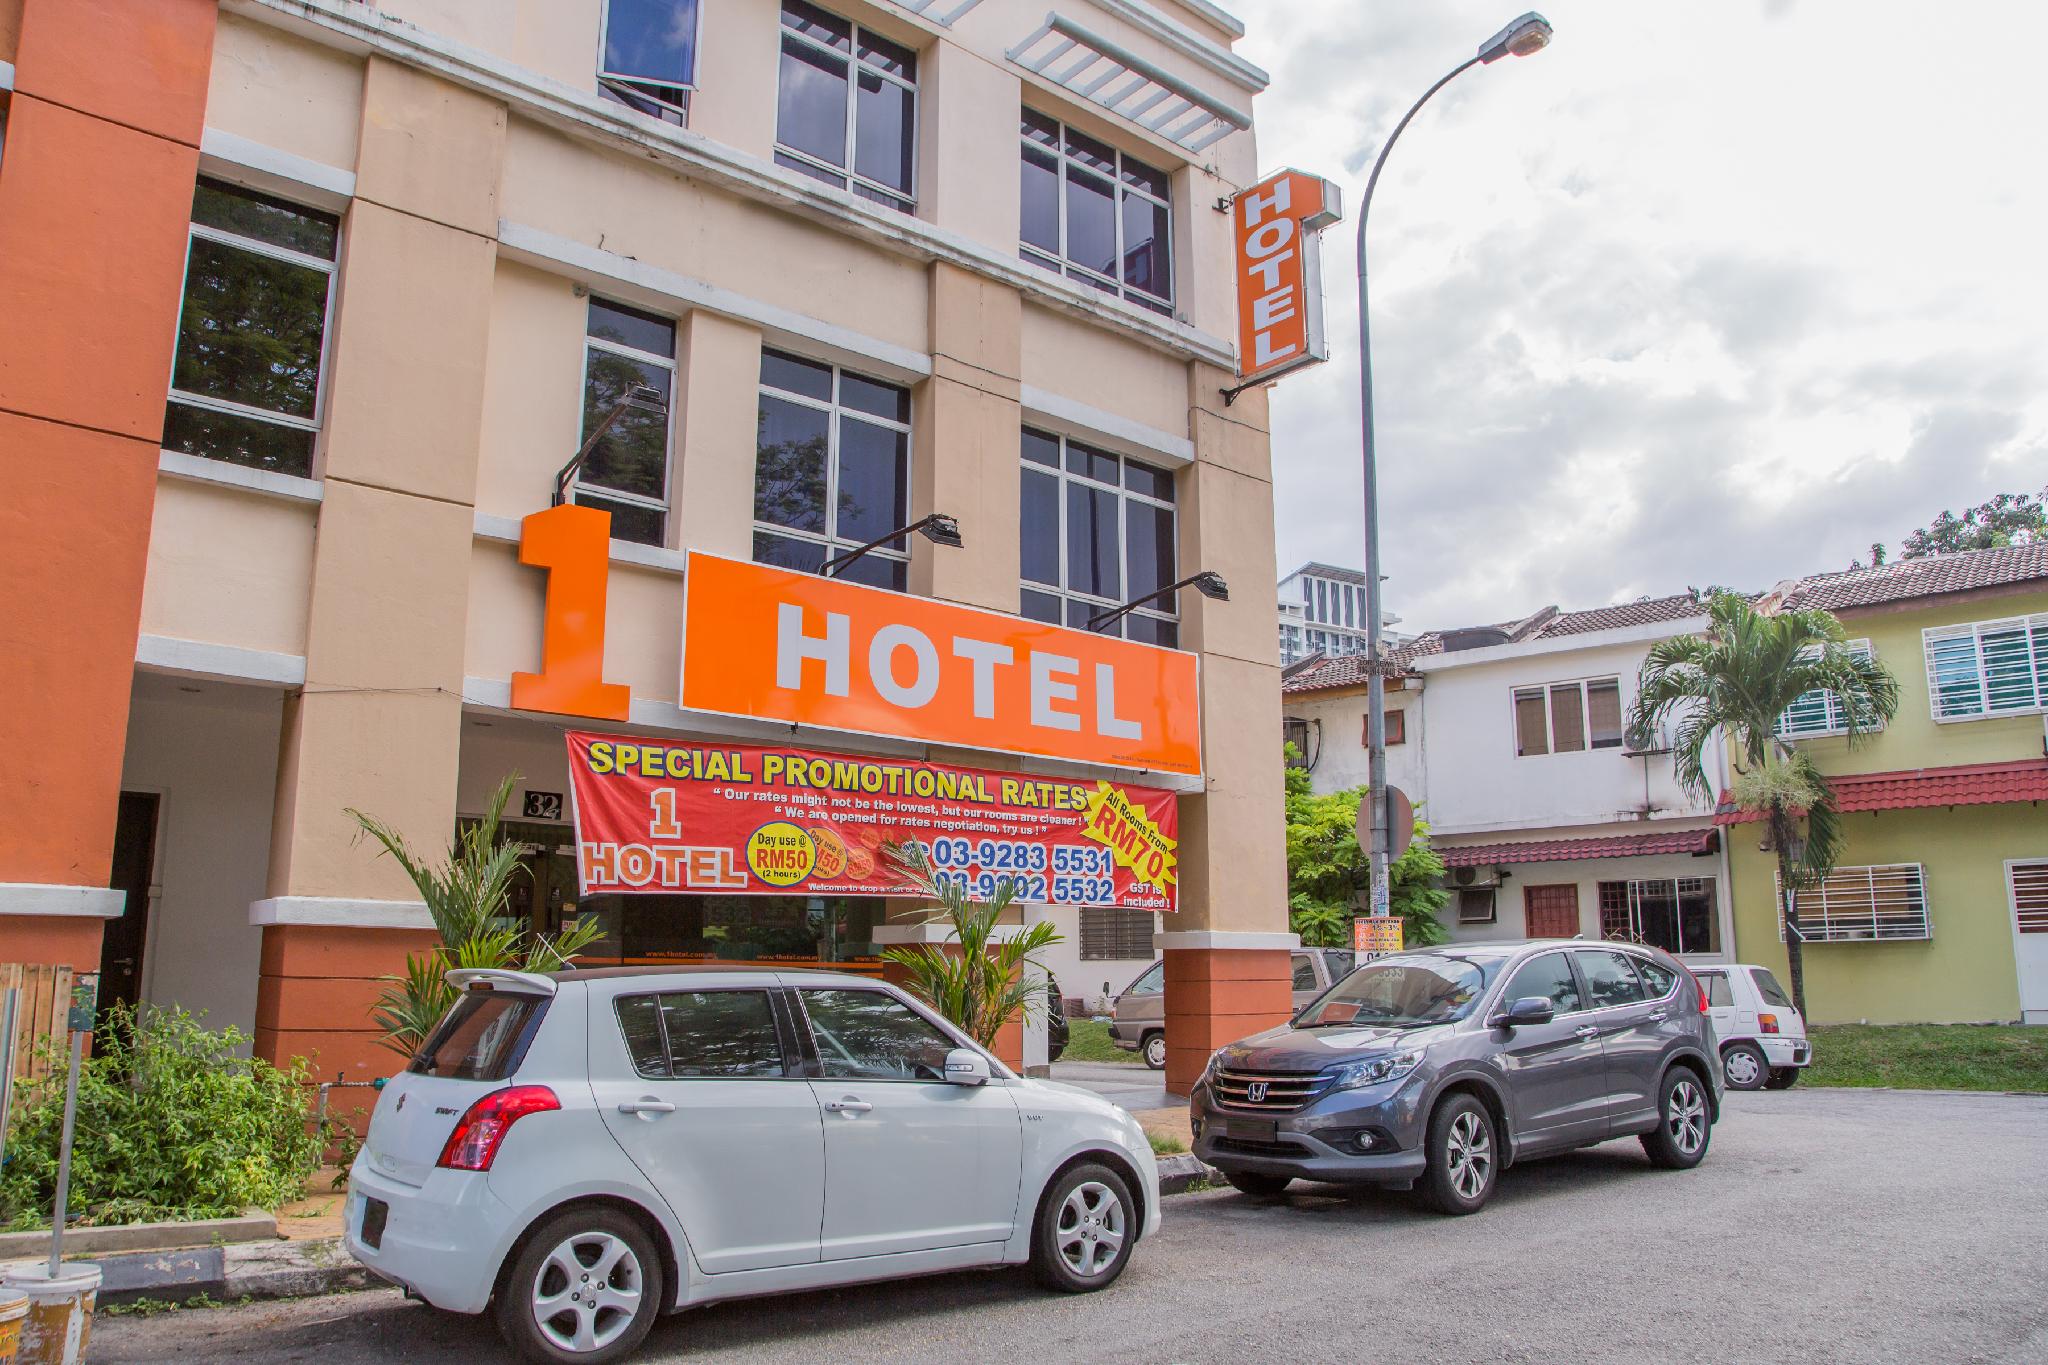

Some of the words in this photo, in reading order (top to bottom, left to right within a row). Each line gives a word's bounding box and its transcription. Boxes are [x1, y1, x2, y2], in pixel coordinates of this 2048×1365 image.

[1244, 176, 1297, 367] HOTEL
[511, 503, 631, 722] 1
[775, 601, 1143, 742] HOTEL
[588, 741, 754, 785] SPECIAL
[761, 753, 995, 805] PROMOTIONAL
[1000, 777, 1089, 812] RATES
[649, 787, 682, 840] 1
[724, 788, 750, 800] Our
[753, 791, 788, 803] rates
[791, 793, 828, 807] might
[831, 797, 852, 808] not
[855, 797, 870, 809] be
[873, 799, 894, 811] the
[896, 800, 939, 816] lowest,
[942, 805, 961, 816] but
[963, 809, 982, 819] our
[984, 811, 1018, 821] rooms
[1021, 813, 1038, 823] are
[1039, 814, 1077, 826] cleaner
[784, 806, 805, 818] We
[808, 810, 829, 820] are
[831, 811, 877, 824] opened
[880, 814, 897, 826] for
[899, 816, 931, 828] rates
[933, 819, 1001, 835] negotiation,
[1002, 823, 1020, 836] try
[1022, 827, 1034, 835] us
[1104, 792, 1121, 809] All
[1118, 802, 1149, 836] Rooms
[1146, 829, 1169, 855] From
[757, 832, 777, 848] Day
[779, 836, 797, 846] use
[798, 834, 807, 848] @
[810, 829, 824, 846] Day
[824, 840, 837, 853] use
[933, 838, 1047, 872] 03-9283
[1053, 847, 1113, 874] 5531
[1093, 802, 1165, 879] RM70
[580, 842, 749, 889] HOTEL
[755, 848, 809, 870] RM50
[762, 869, 772, 878] (2
[773, 871, 801, 879] hours)
[808, 883, 848, 892] Welcome
[849, 884, 858, 892] to
[860, 884, 878, 894] drop
[1053, 877, 1114, 903] 5532
[1123, 896, 1165, 909] included
[1129, 882, 1151, 895] GST
[1152, 885, 1163, 895] is
